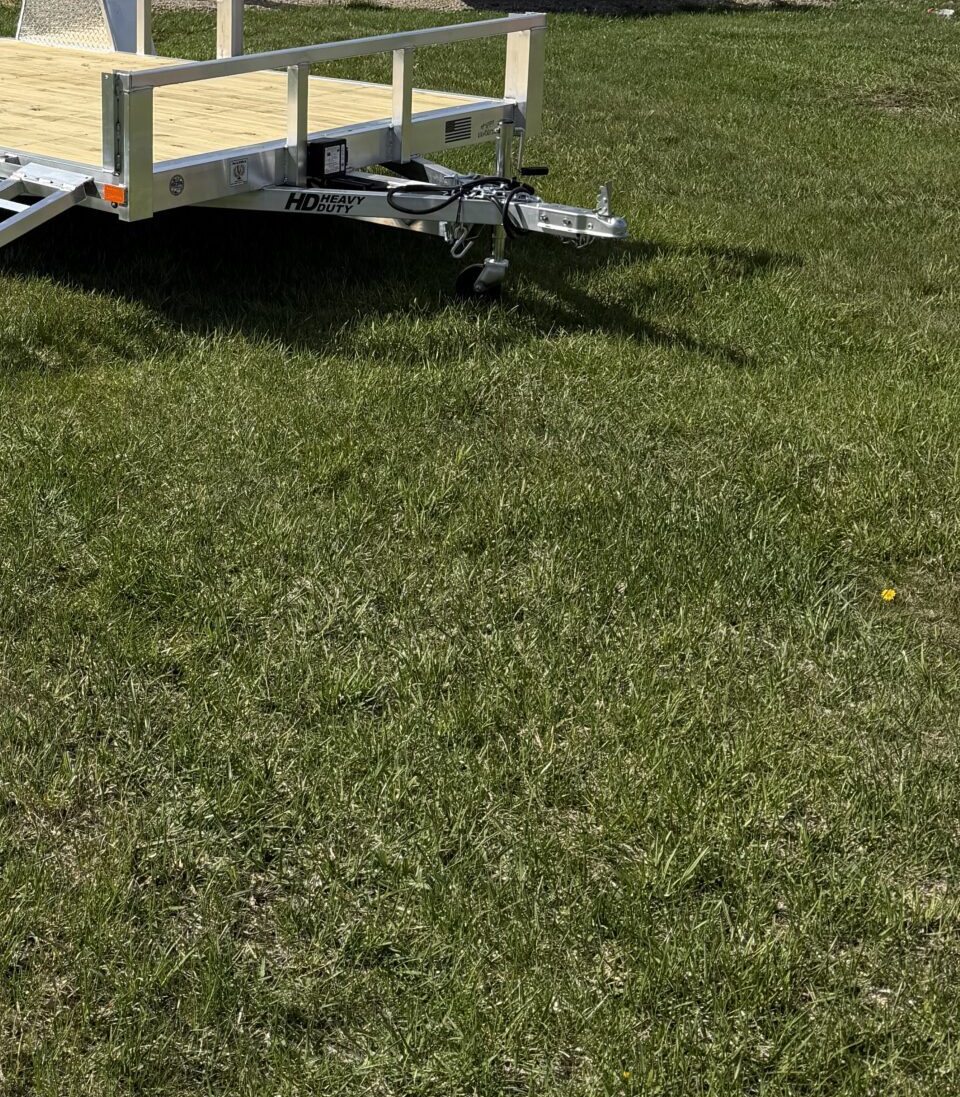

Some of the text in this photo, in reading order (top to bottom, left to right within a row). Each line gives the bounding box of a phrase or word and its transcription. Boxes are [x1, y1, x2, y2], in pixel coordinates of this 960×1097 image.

[284, 192, 366, 211] HD HEAVY
[316, 204, 353, 213] DUTY
